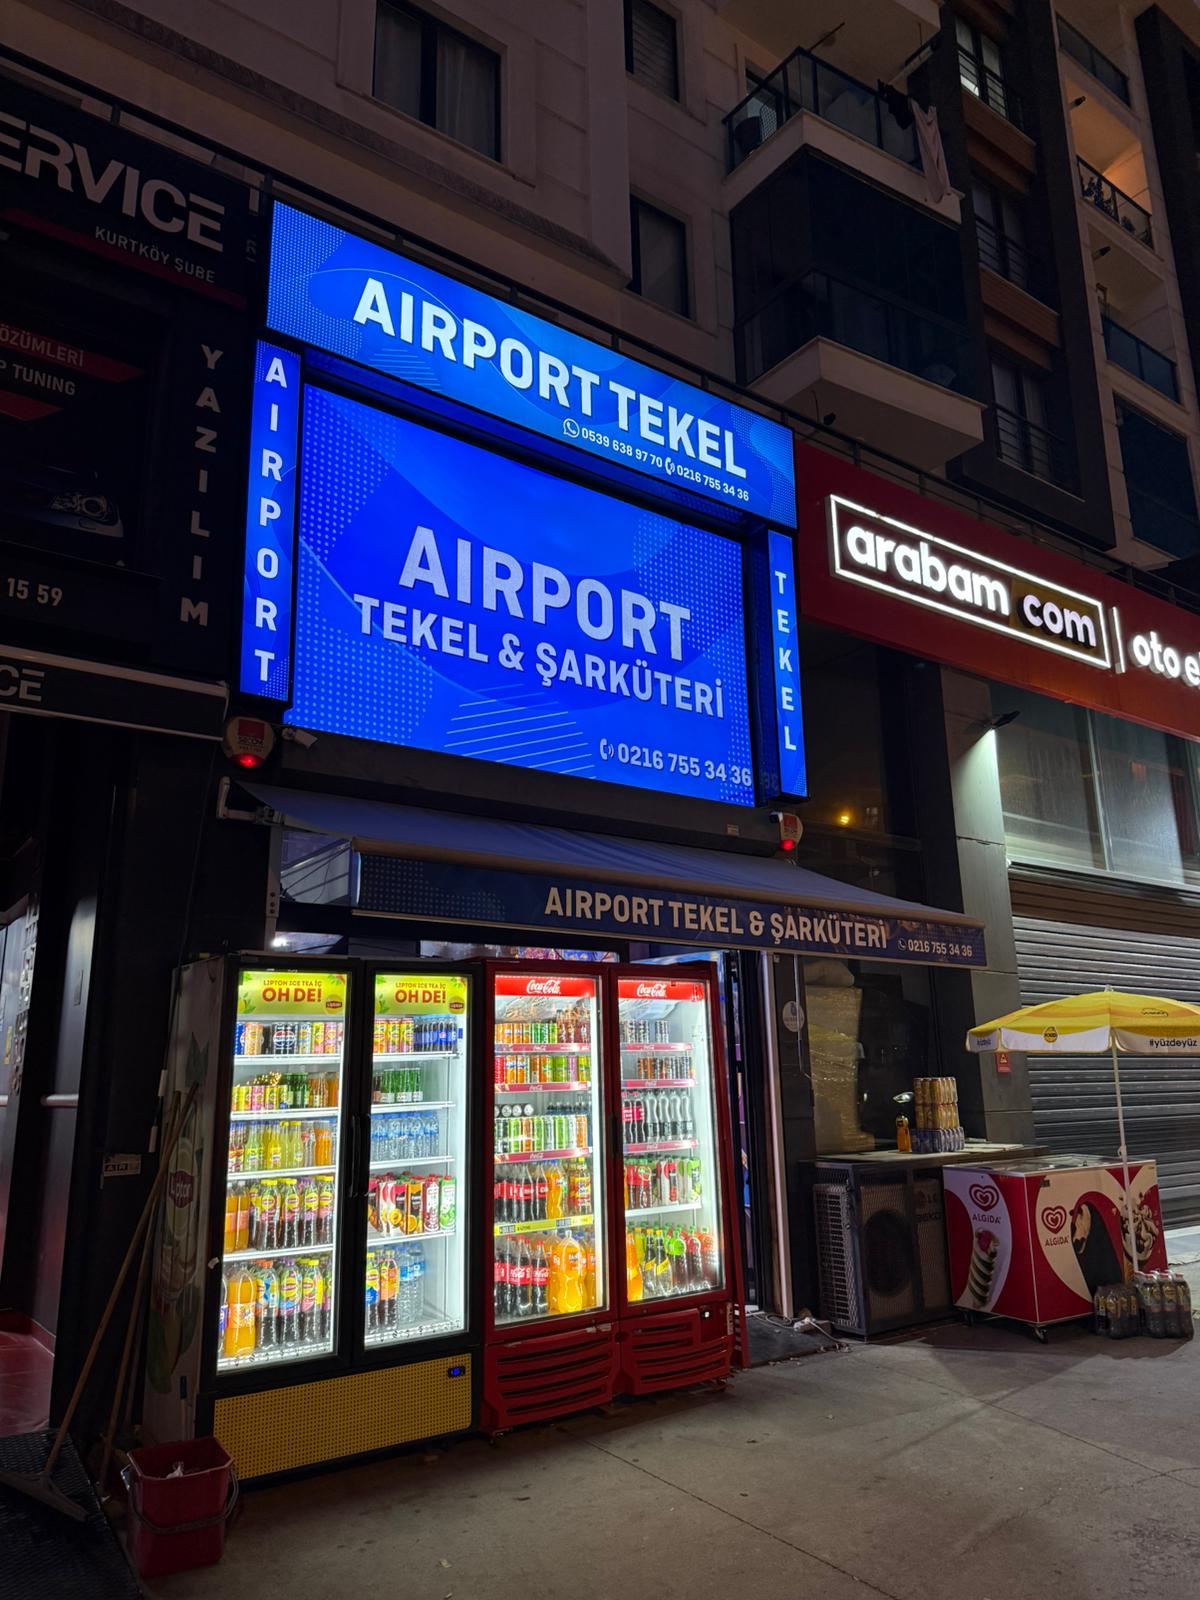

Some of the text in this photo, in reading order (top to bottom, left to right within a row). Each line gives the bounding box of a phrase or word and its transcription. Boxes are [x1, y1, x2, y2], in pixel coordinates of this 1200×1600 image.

[95, 226, 216, 284] KURTKÖY ŞUBE
[12, 363, 76, 396] TUNING
[353, 277, 747, 479] AIRPORT TEKEL
[179, 343, 224, 627] YAZILIM
[581, 426, 750, 501] 0539 638 97 70 0216 755 34 36
[254, 356, 288, 681] AIRPORT
[7, 577, 63, 607] 15 59
[398, 525, 691, 661] AIRPORT
[846, 526, 1096, 647] arabam com
[353, 593, 724, 719] TEKEL & ŞARKÜTERİ
[774, 570, 797, 751] TEKEL
[1132, 631, 1181, 679] oto
[617, 743, 753, 787] 0216 755 34 36
[544, 886, 887, 949] AIRPORT TEKEL & ŞARKÜTERİ
[907, 939, 973, 957] 0216 755 34 36
[262, 987, 322, 1003] OH DE!
[395, 989, 446, 1004] OH DE!
[526, 979, 560, 995] Coca-Cola
[972, 1214, 1000, 1225] ALGIDA
[1045, 1235, 1069, 1247] ALGIDA
